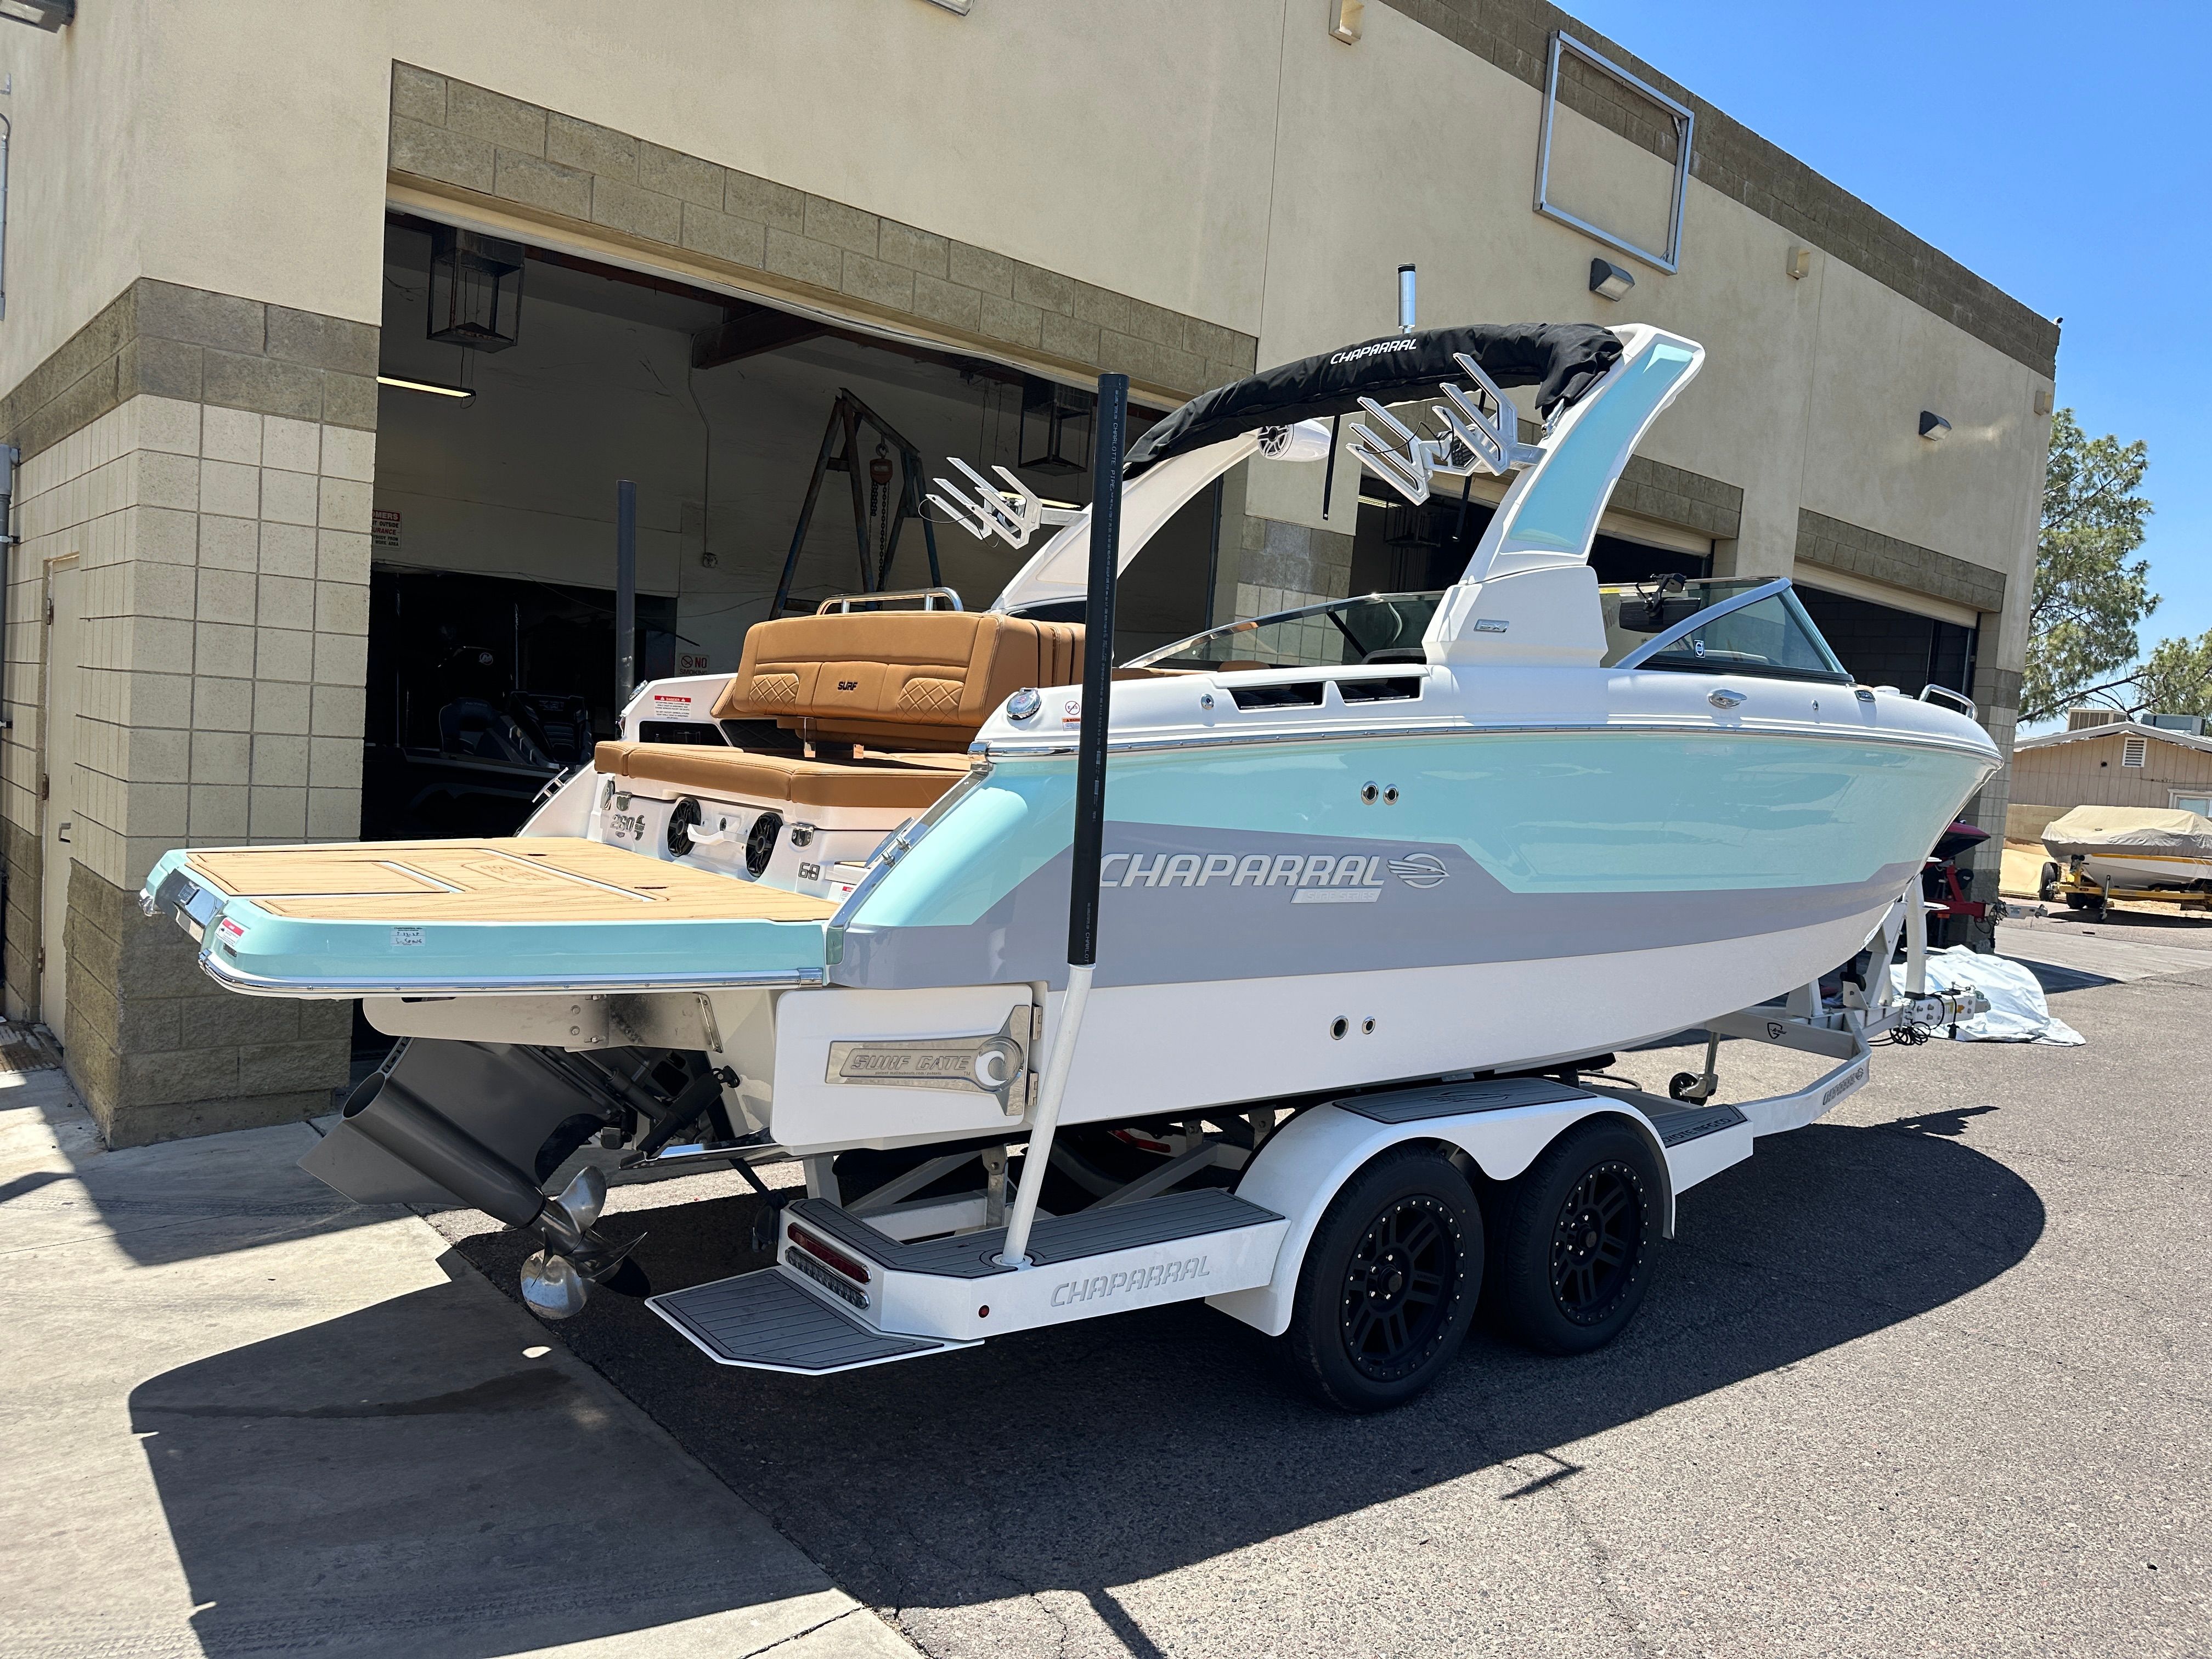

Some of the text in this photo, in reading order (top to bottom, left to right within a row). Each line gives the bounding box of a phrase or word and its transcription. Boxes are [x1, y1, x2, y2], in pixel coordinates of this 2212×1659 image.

[1330, 338, 1417, 365] CHAPARRAL
[695, 657, 707, 668] NO
[837, 681, 858, 691] SURF
[1099, 853, 1384, 888] CHAPARRAL
[1307, 891, 1374, 900] SURF SERIES
[851, 1055, 971, 1070] SURF GATE
[1050, 1255, 1210, 1307] CHAPARRAL
